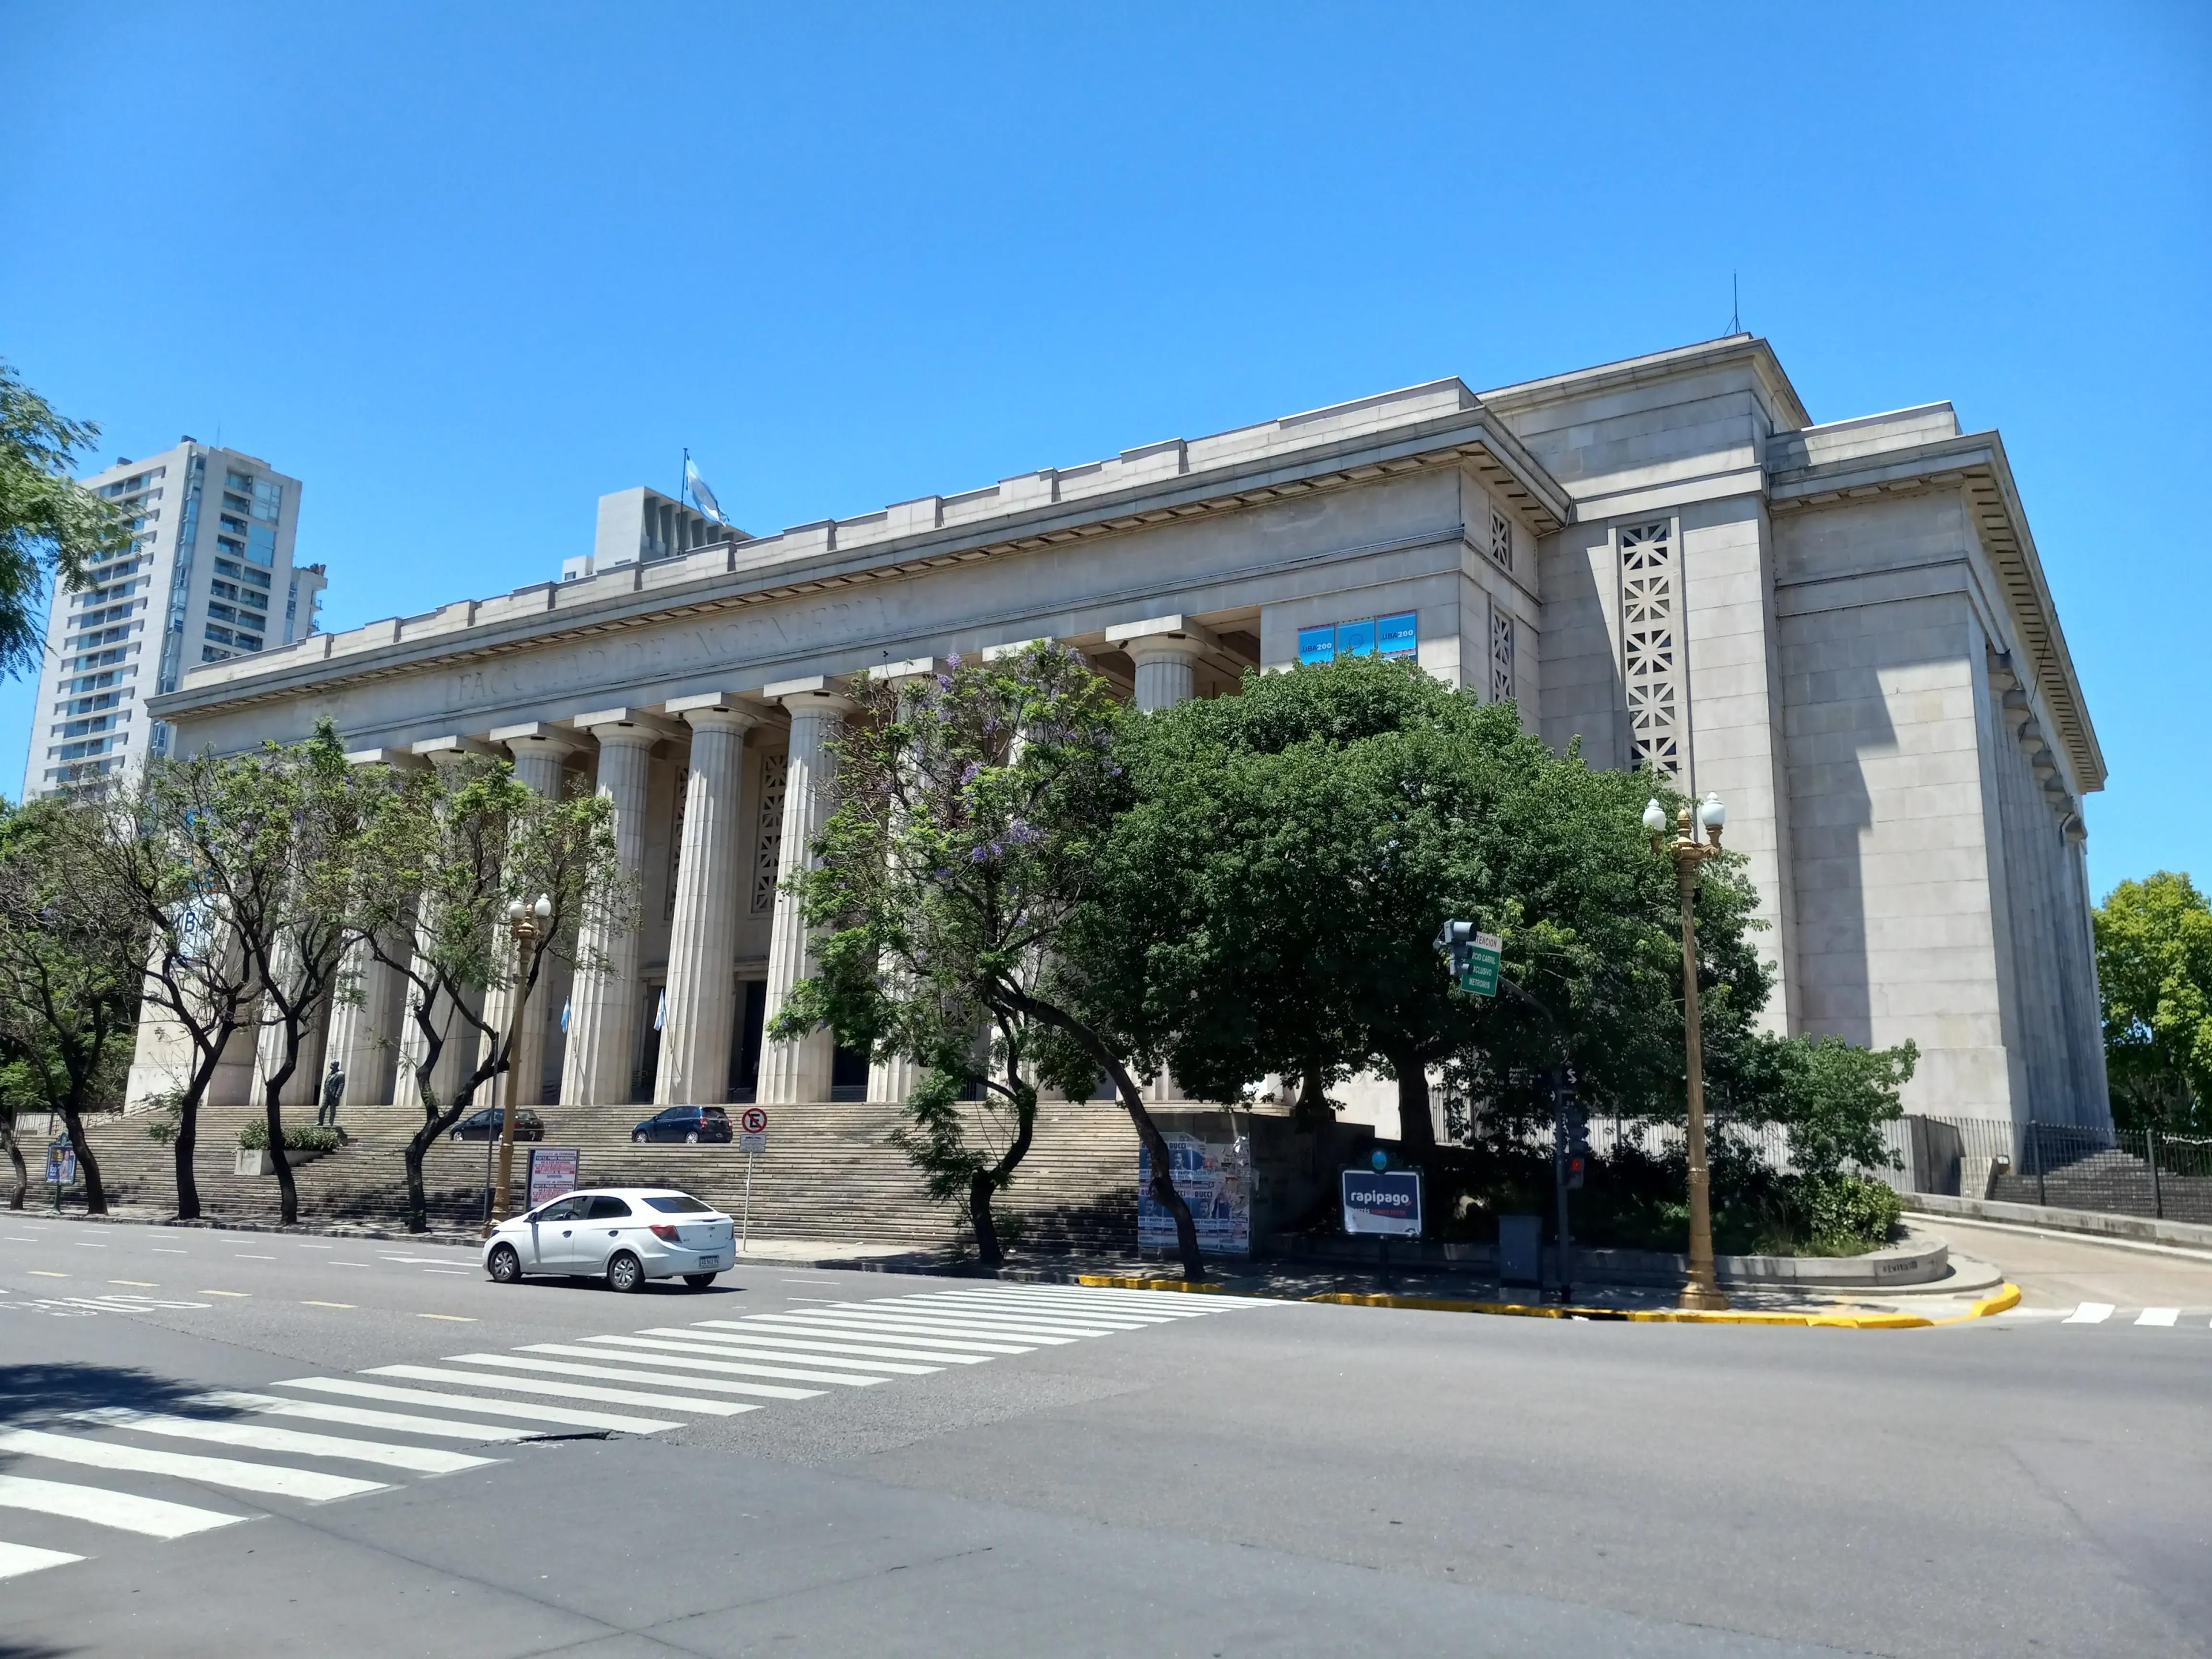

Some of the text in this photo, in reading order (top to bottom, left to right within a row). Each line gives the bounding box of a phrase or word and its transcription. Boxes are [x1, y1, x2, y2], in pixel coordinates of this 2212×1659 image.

[624, 637, 665, 671] DE
[1475, 935, 1497, 948] TENCION
[1473, 965, 1492, 976] XCLUSIVO
[1350, 1190, 1410, 1206] rapipago
